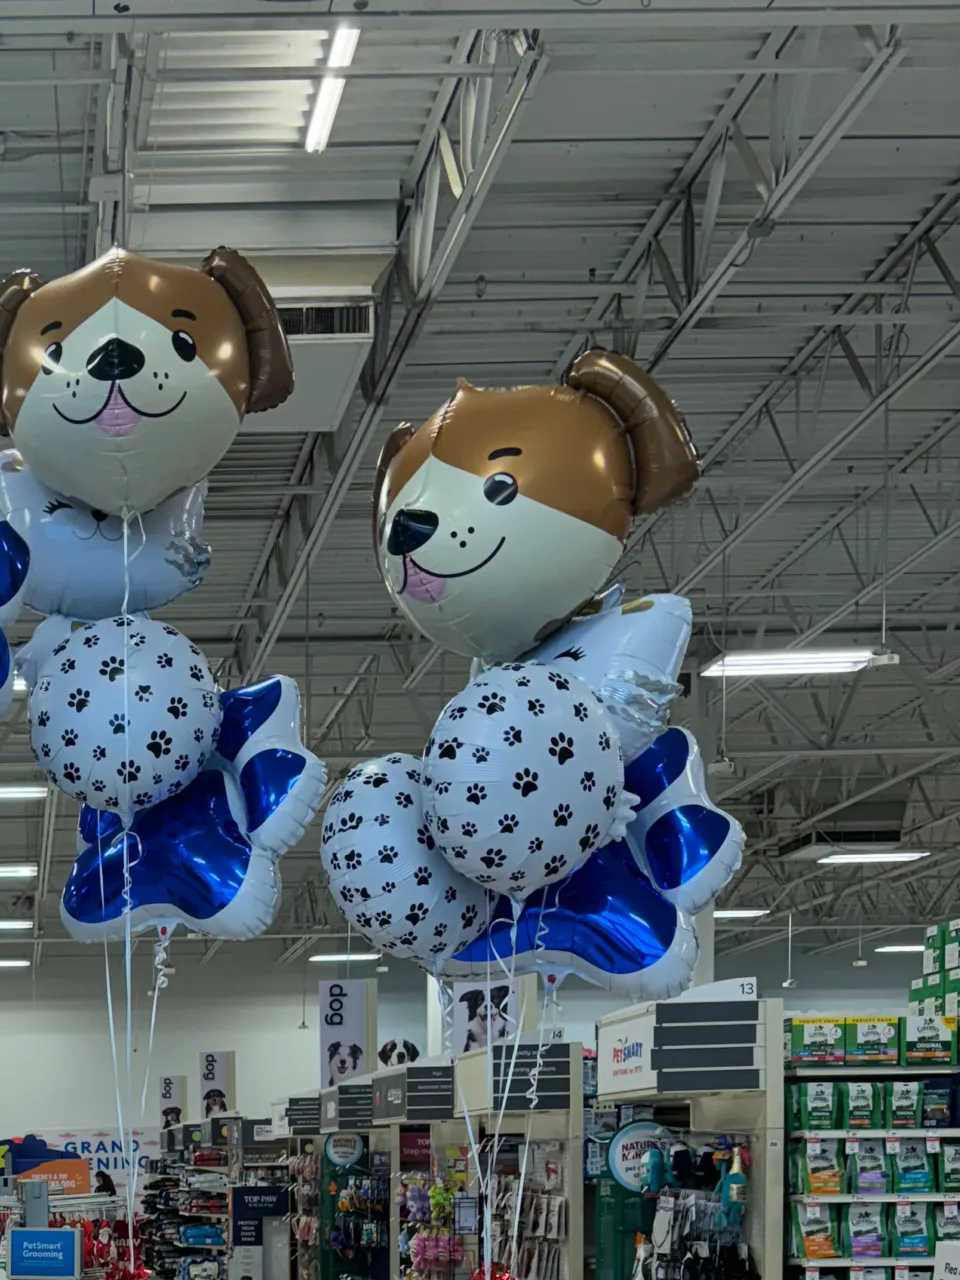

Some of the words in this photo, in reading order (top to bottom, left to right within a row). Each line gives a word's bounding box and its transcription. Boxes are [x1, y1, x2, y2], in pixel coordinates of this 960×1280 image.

[739, 982, 755, 995] 13
[324, 983, 348, 1026] dog
[552, 1030, 562, 1039] 14
[203, 1054, 218, 1081] dog
[162, 1077, 173, 1099] dog
[64, 1140, 139, 1153] GRAND
[403, 1147, 420, 1155] Step
[89, 1155, 150, 1170] ENING
[23, 1242, 61, 1250] PetSmart
[23, 1250, 63, 1260] Grooming
[944, 1262, 957, 1276] Flea
